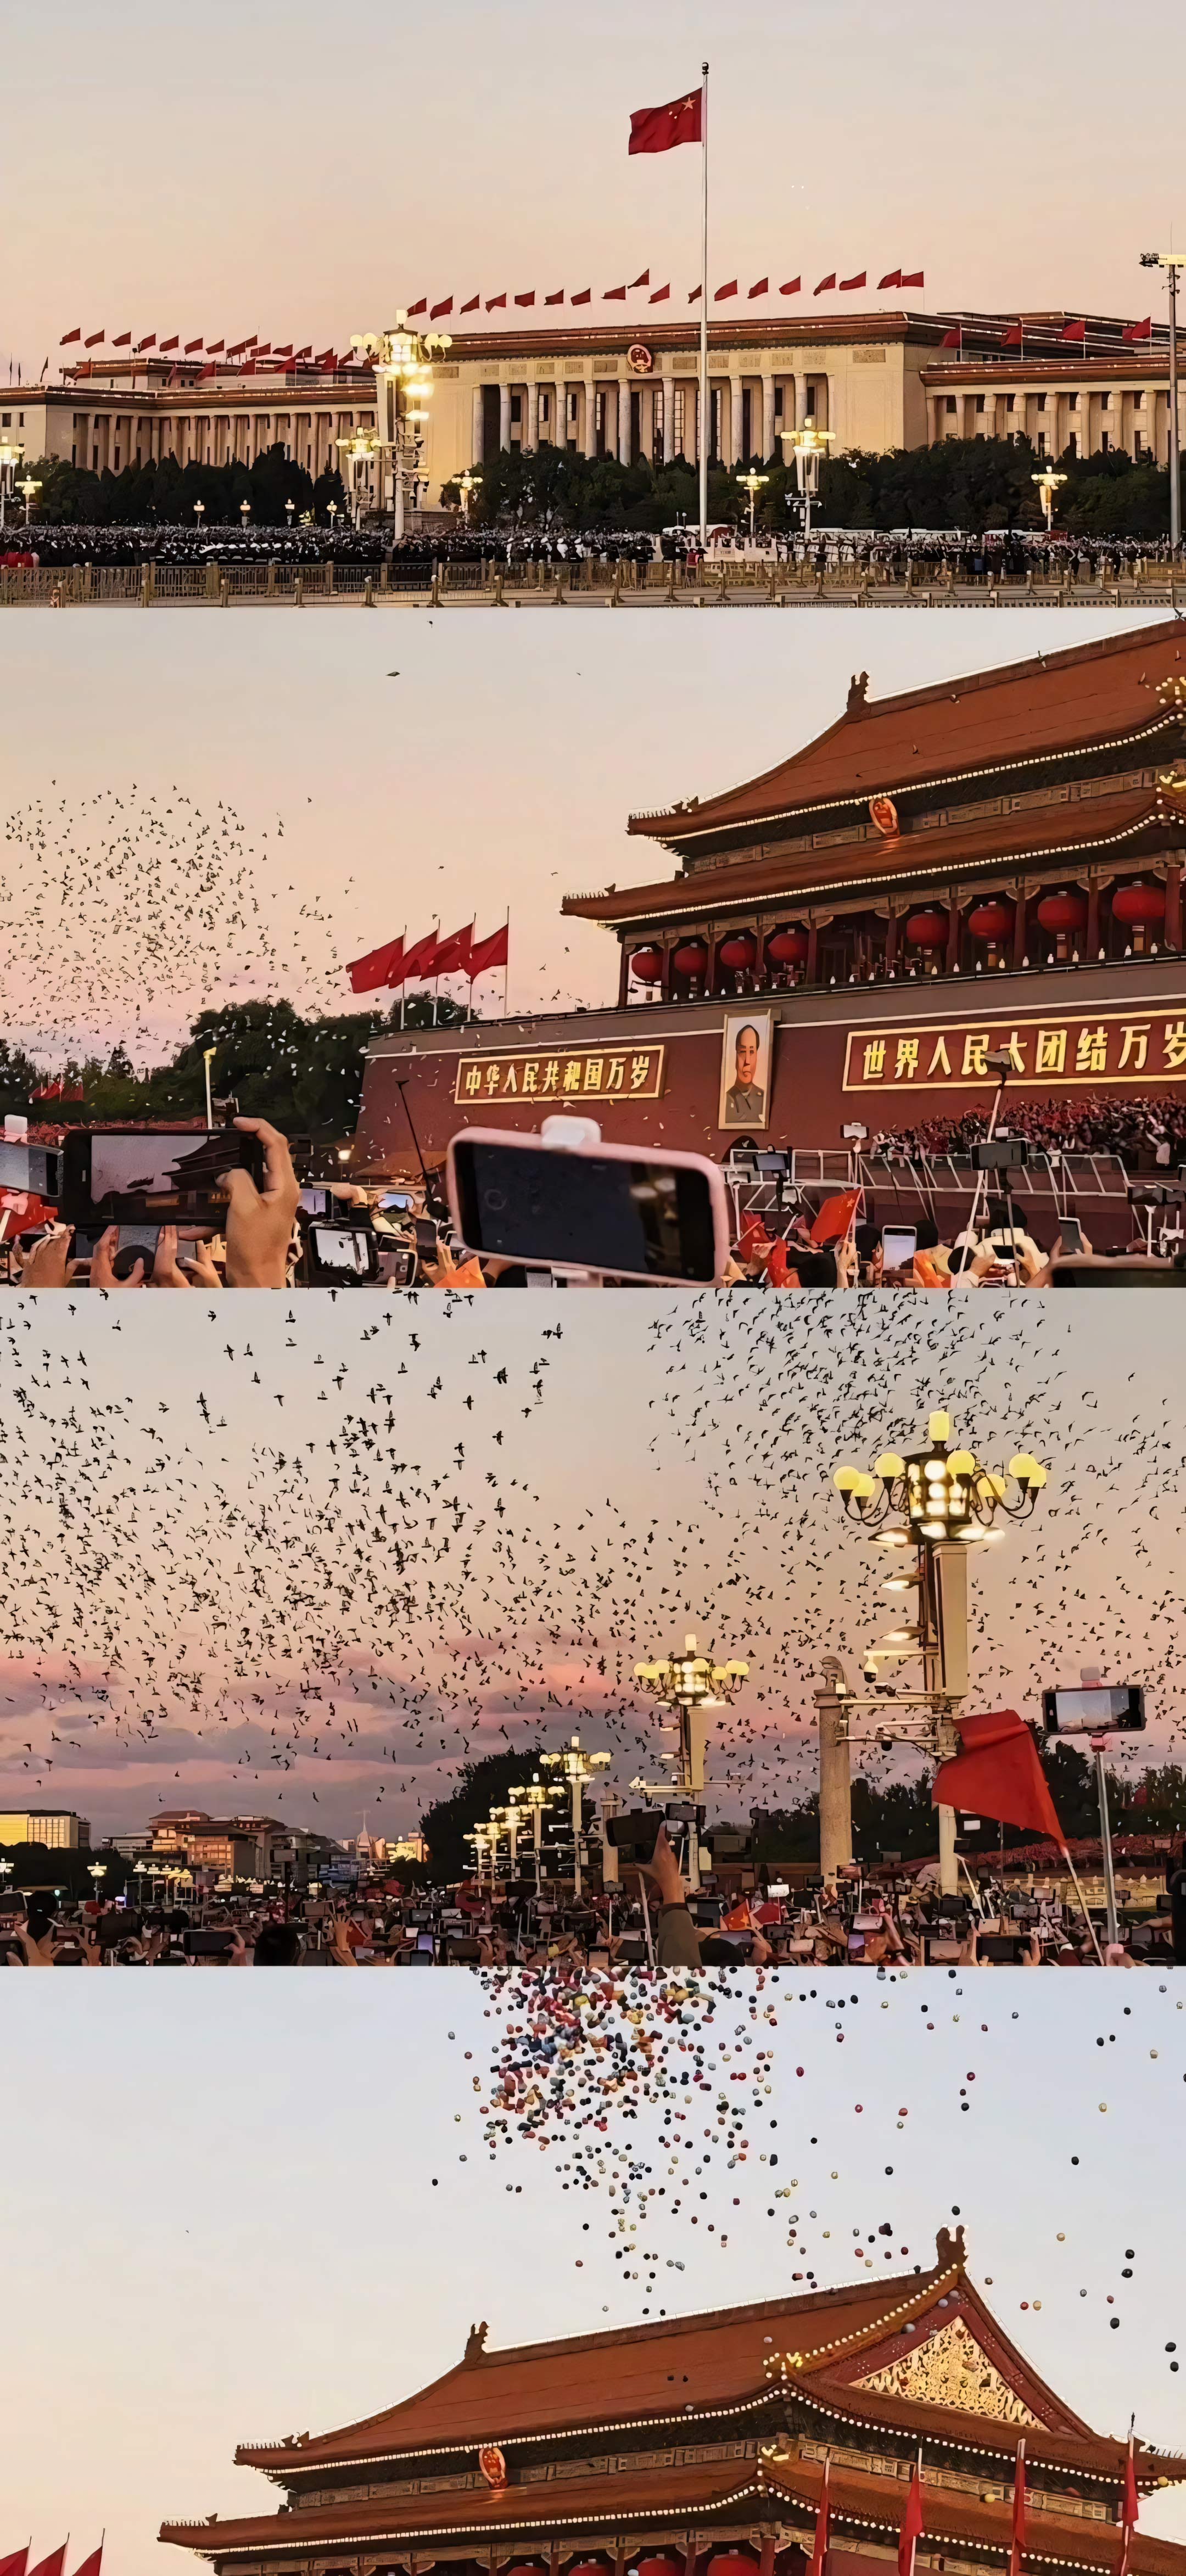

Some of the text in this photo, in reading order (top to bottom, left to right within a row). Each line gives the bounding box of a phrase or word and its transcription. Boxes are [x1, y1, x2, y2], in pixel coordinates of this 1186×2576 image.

[466, 1055, 650, 1095] 中华人民共和国万岁
